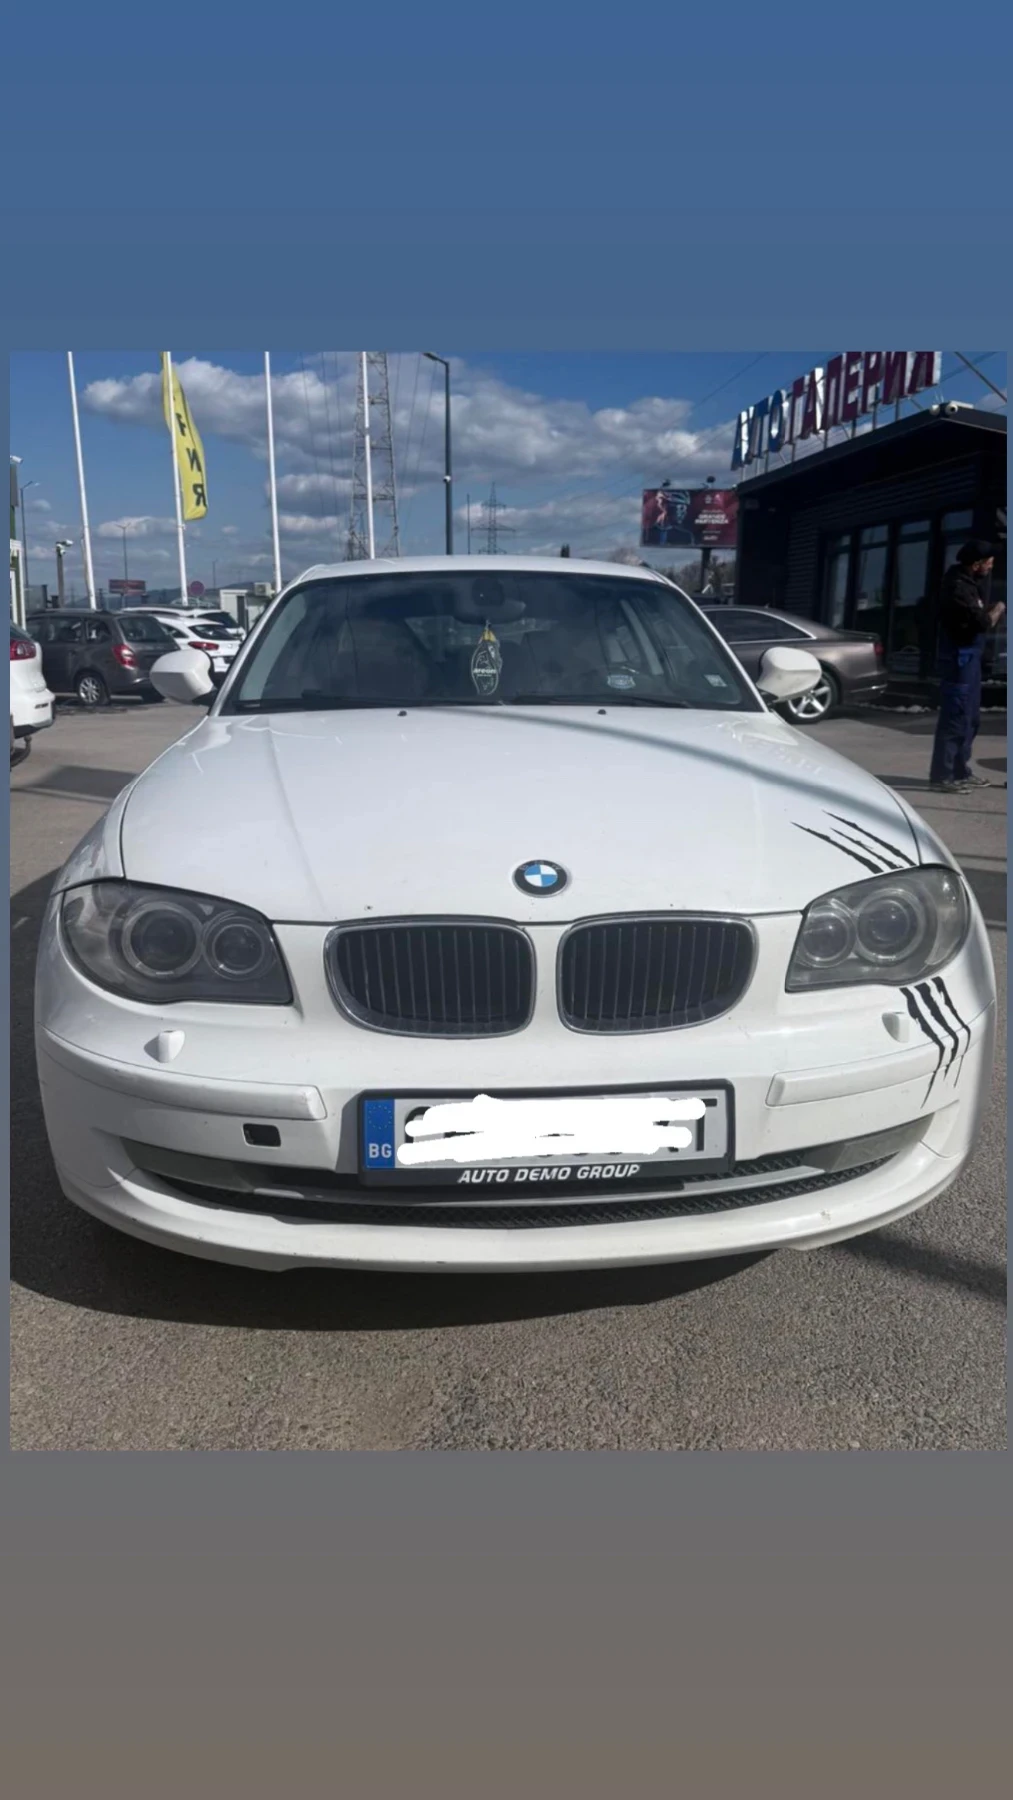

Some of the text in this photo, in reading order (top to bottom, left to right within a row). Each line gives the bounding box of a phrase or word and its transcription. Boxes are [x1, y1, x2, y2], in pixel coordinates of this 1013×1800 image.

[368, 1143, 392, 1158] BG
[457, 1164, 641, 1183] AUTO DEMO GROUP
